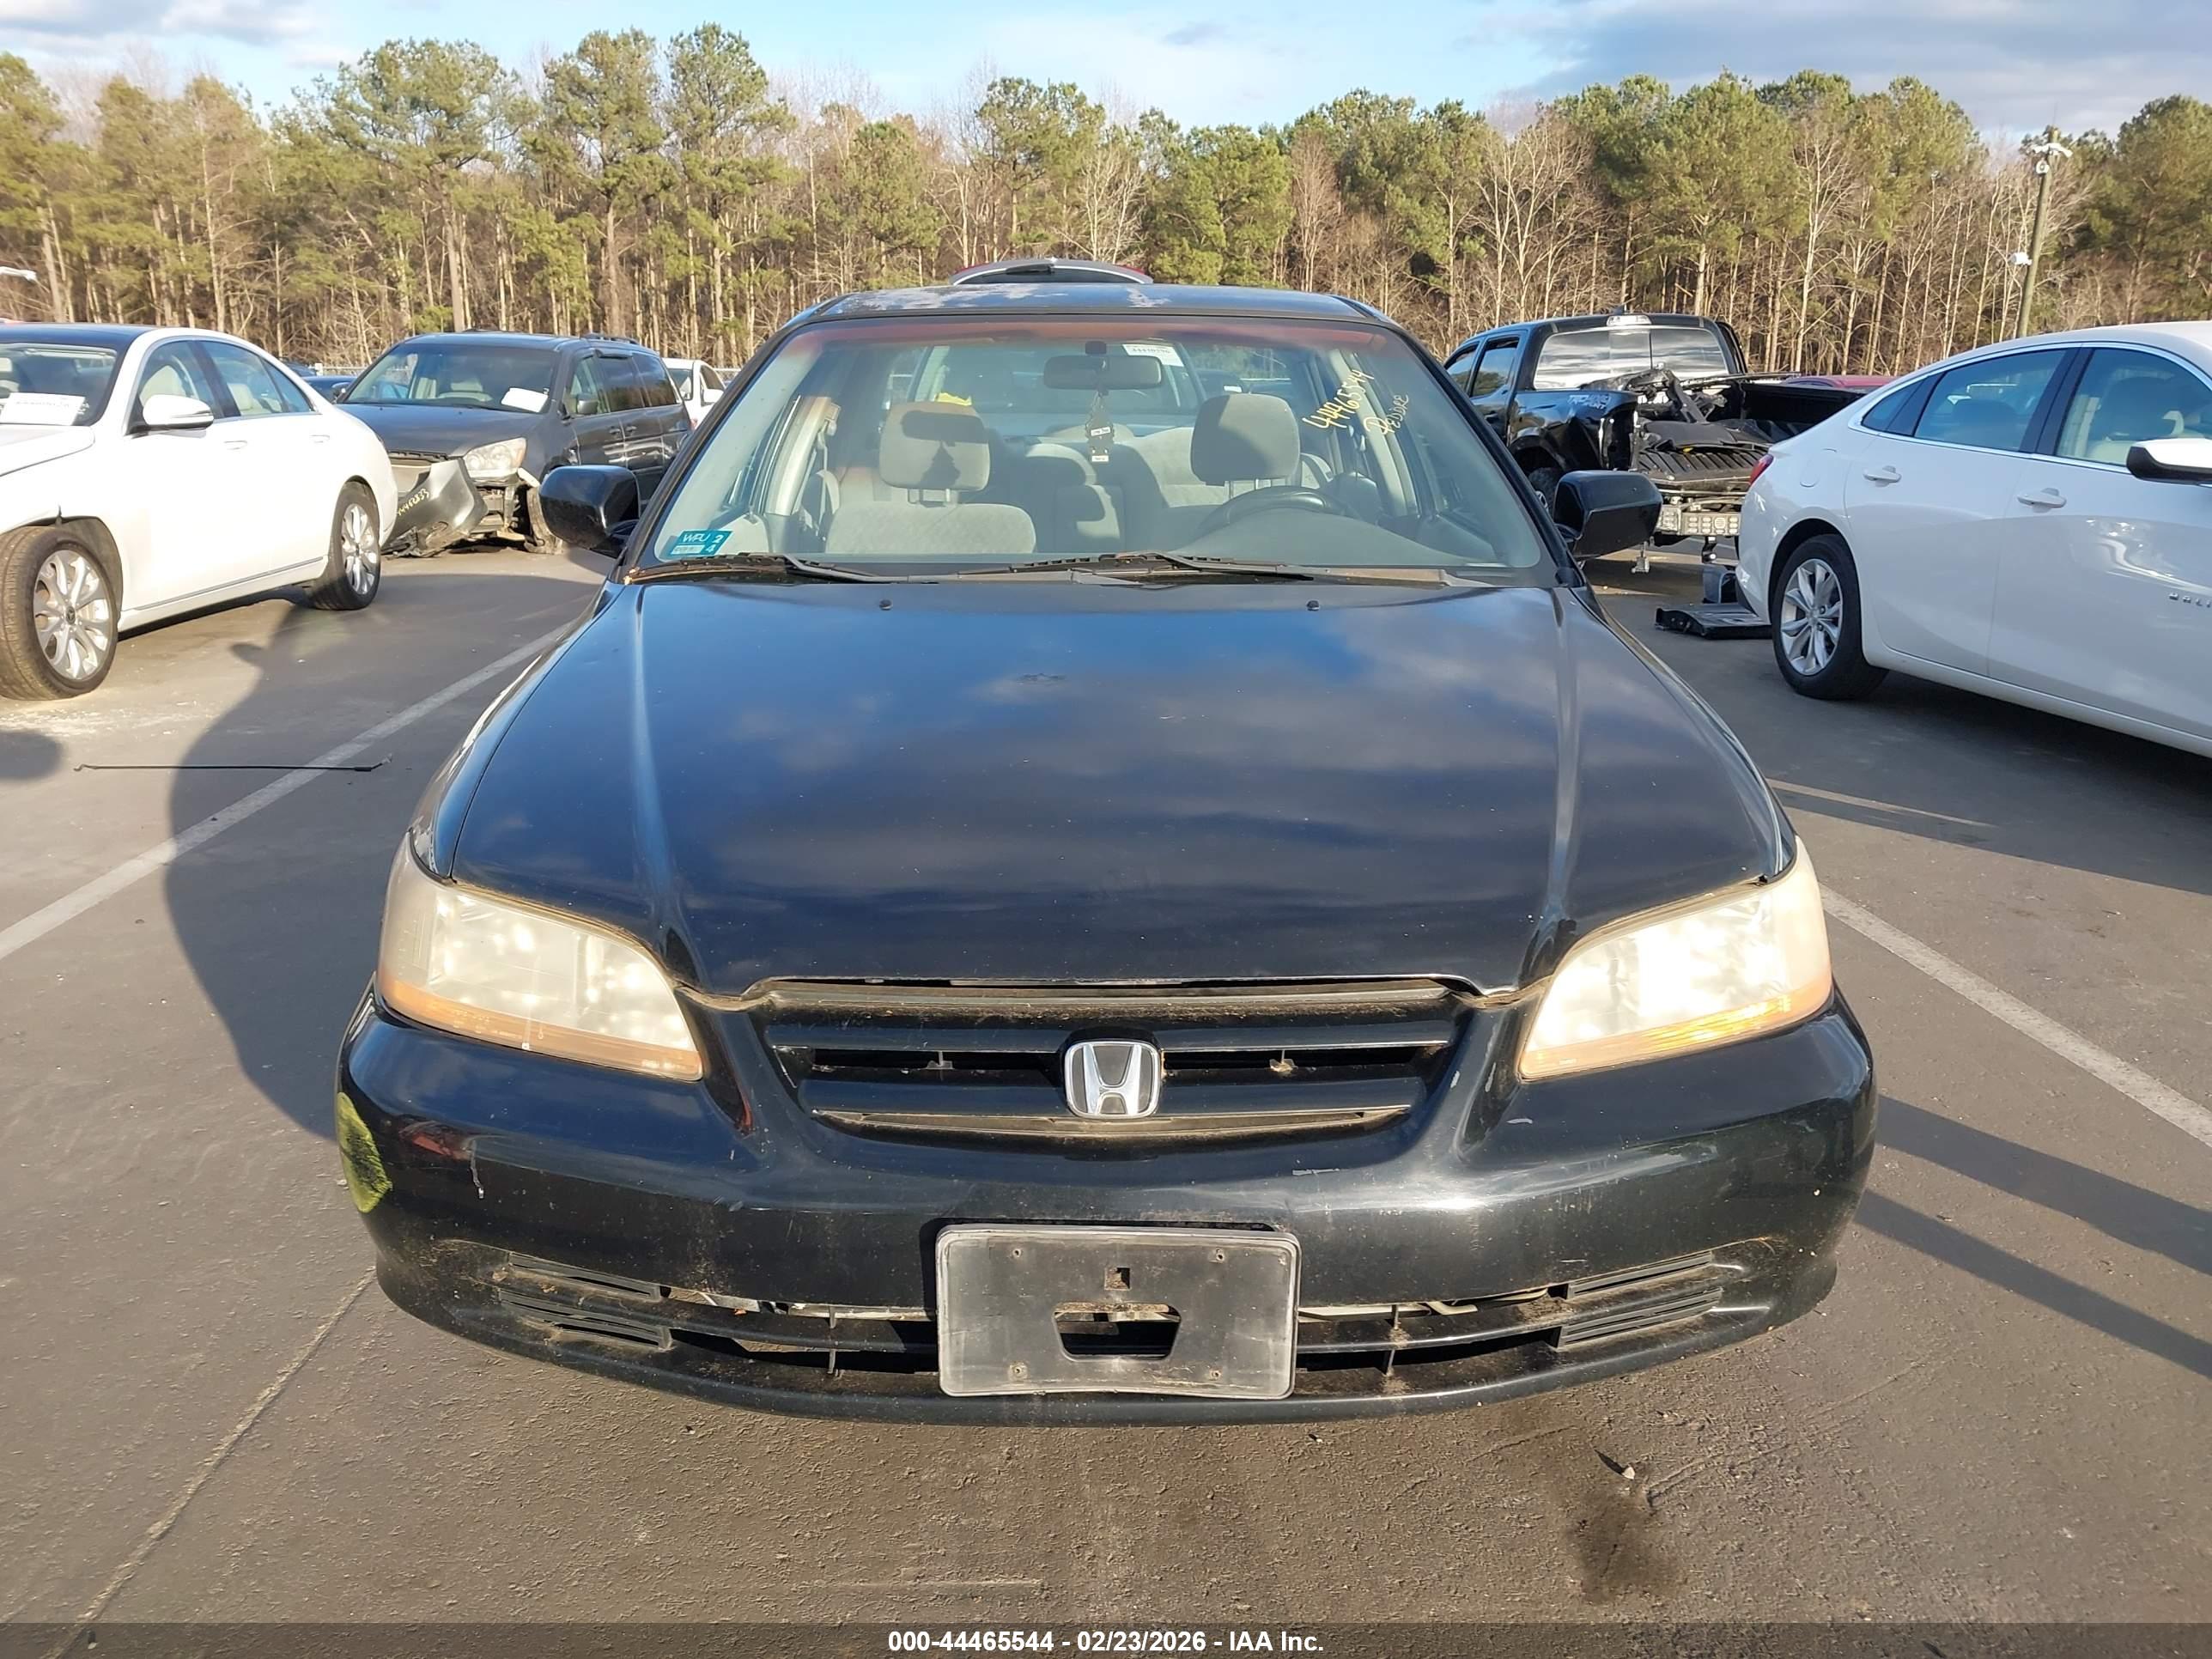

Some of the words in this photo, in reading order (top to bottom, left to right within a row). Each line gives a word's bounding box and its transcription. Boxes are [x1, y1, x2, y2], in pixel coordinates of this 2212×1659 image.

[1302, 369, 1375, 428] 44465544
[712, 534, 725, 544] 2
[704, 544, 717, 553] 4
